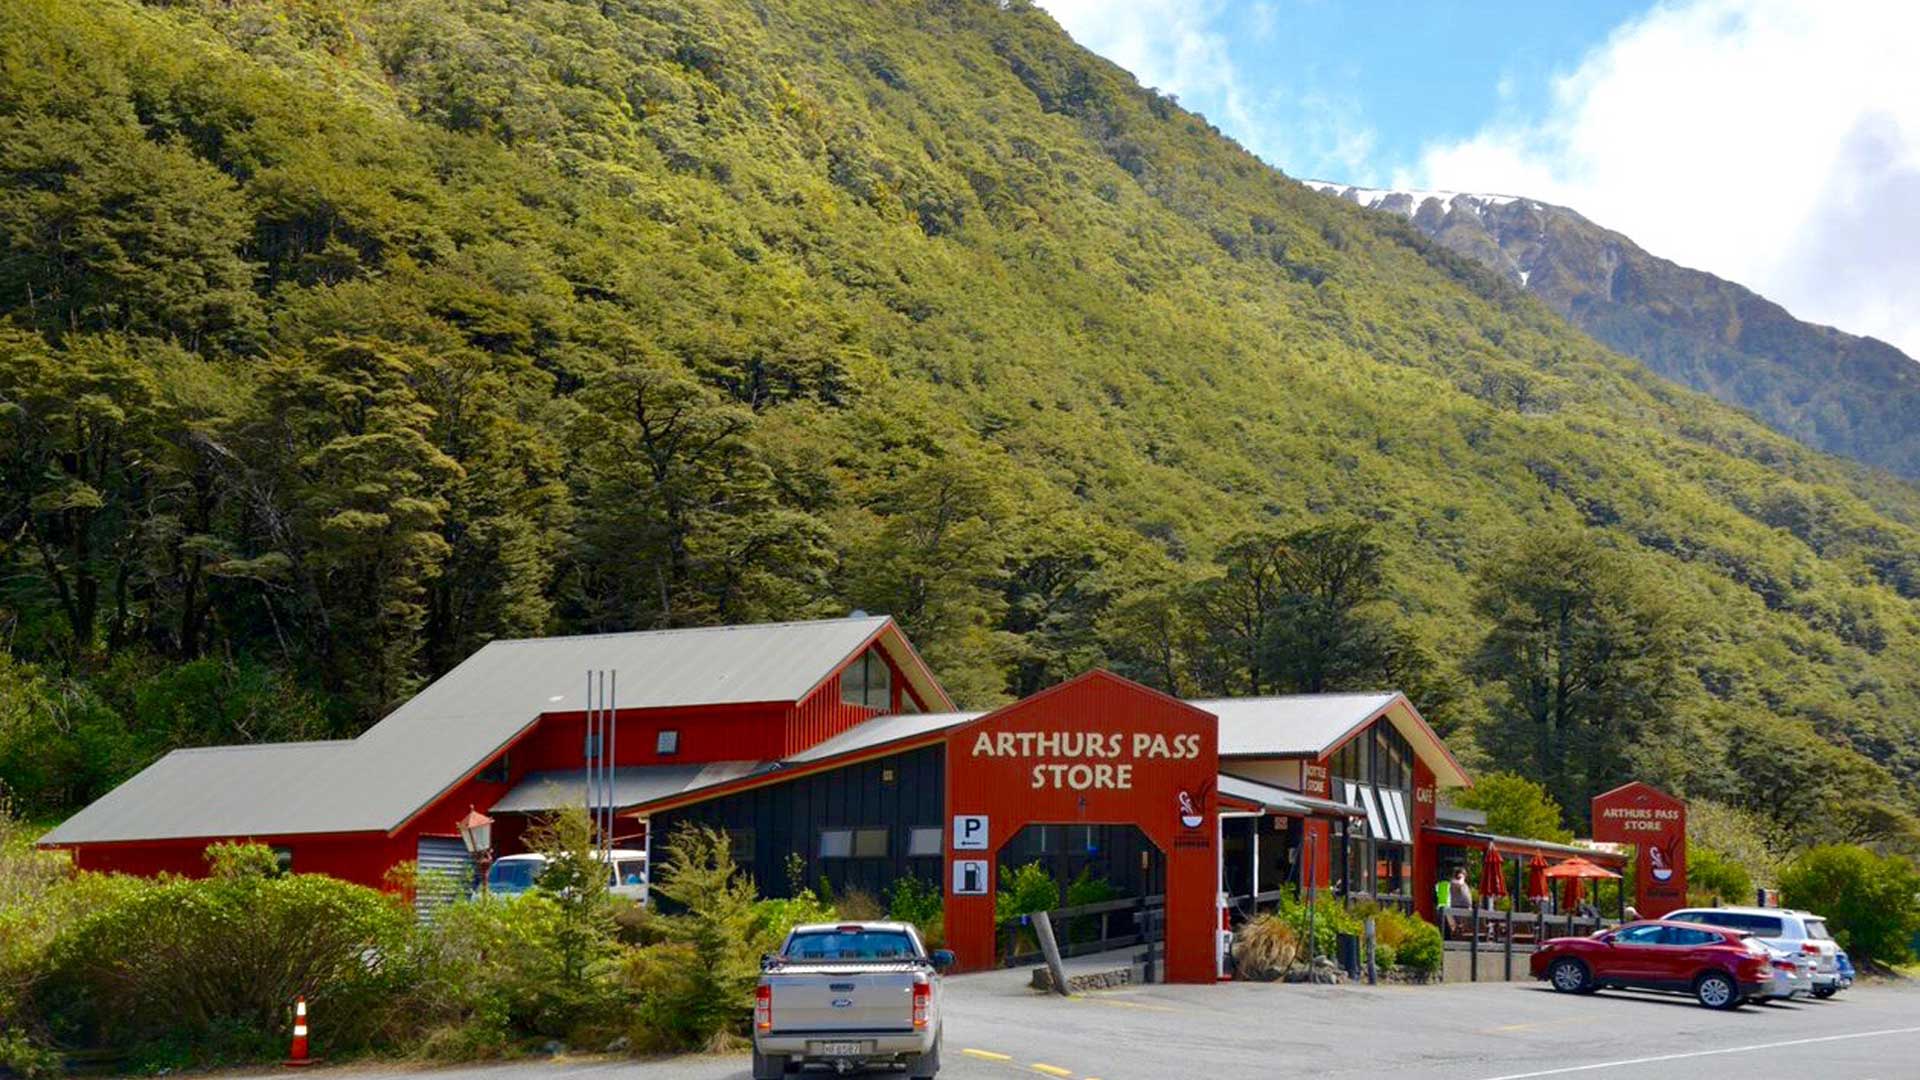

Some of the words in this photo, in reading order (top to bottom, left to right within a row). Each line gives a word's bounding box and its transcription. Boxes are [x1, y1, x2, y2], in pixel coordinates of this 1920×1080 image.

[972, 732, 1123, 757] ARTHURS
[1132, 734, 1200, 758] PASS
[1032, 764, 1133, 789] STORE
[1604, 808, 1652, 819] ARTHURS
[1654, 810, 1680, 820] PASS
[965, 819, 980, 838] P
[1624, 821, 1662, 831] STORE
